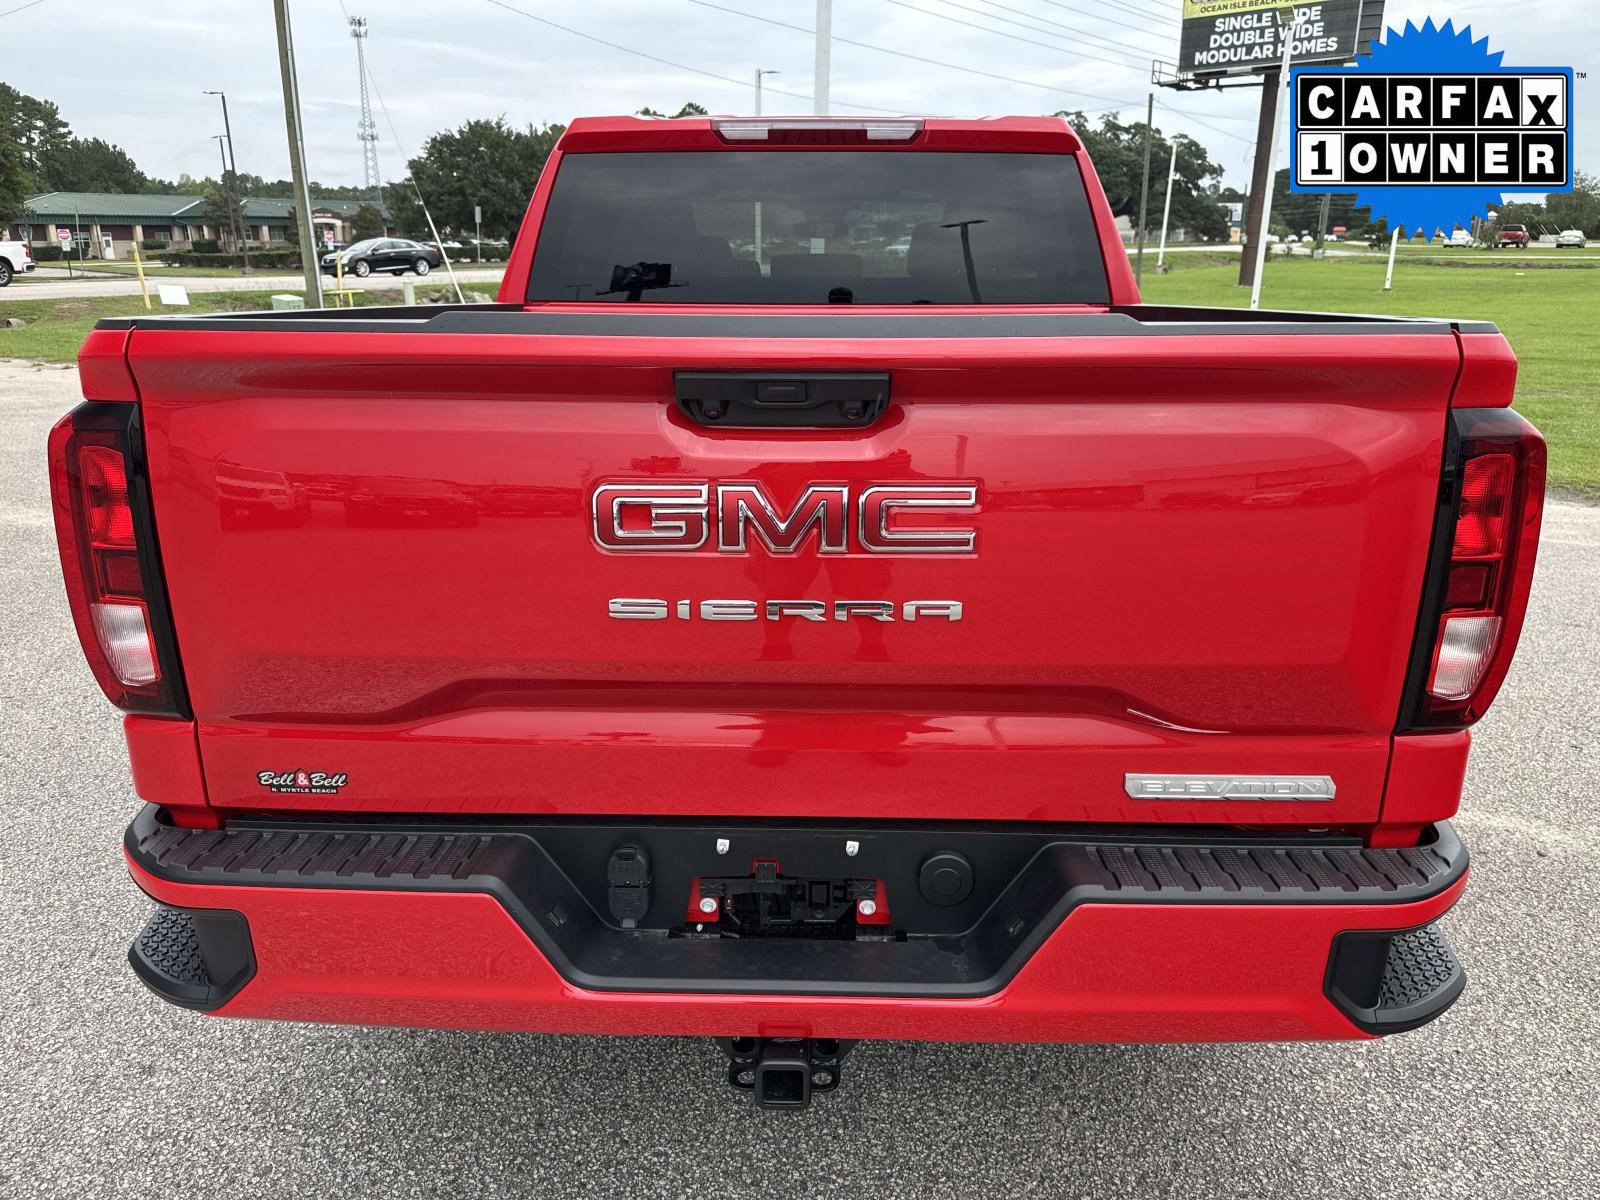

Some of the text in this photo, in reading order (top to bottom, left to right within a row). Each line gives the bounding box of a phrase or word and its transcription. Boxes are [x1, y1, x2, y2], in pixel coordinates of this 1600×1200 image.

[1200, 4, 1228, 13] OCEAN
[1230, 2, 1247, 10] ISLE
[1215, 12, 1273, 32] SINGLE
[1210, 22, 1325, 48] DOUBLE WIDE
[1194, 37, 1338, 65] MODULAR HOMES
[591, 482, 978, 555] GMC
[608, 598, 964, 622] SIERRA
[258, 771, 347, 787] Bell & Bell
[1141, 778, 1322, 796] ELEVATION
